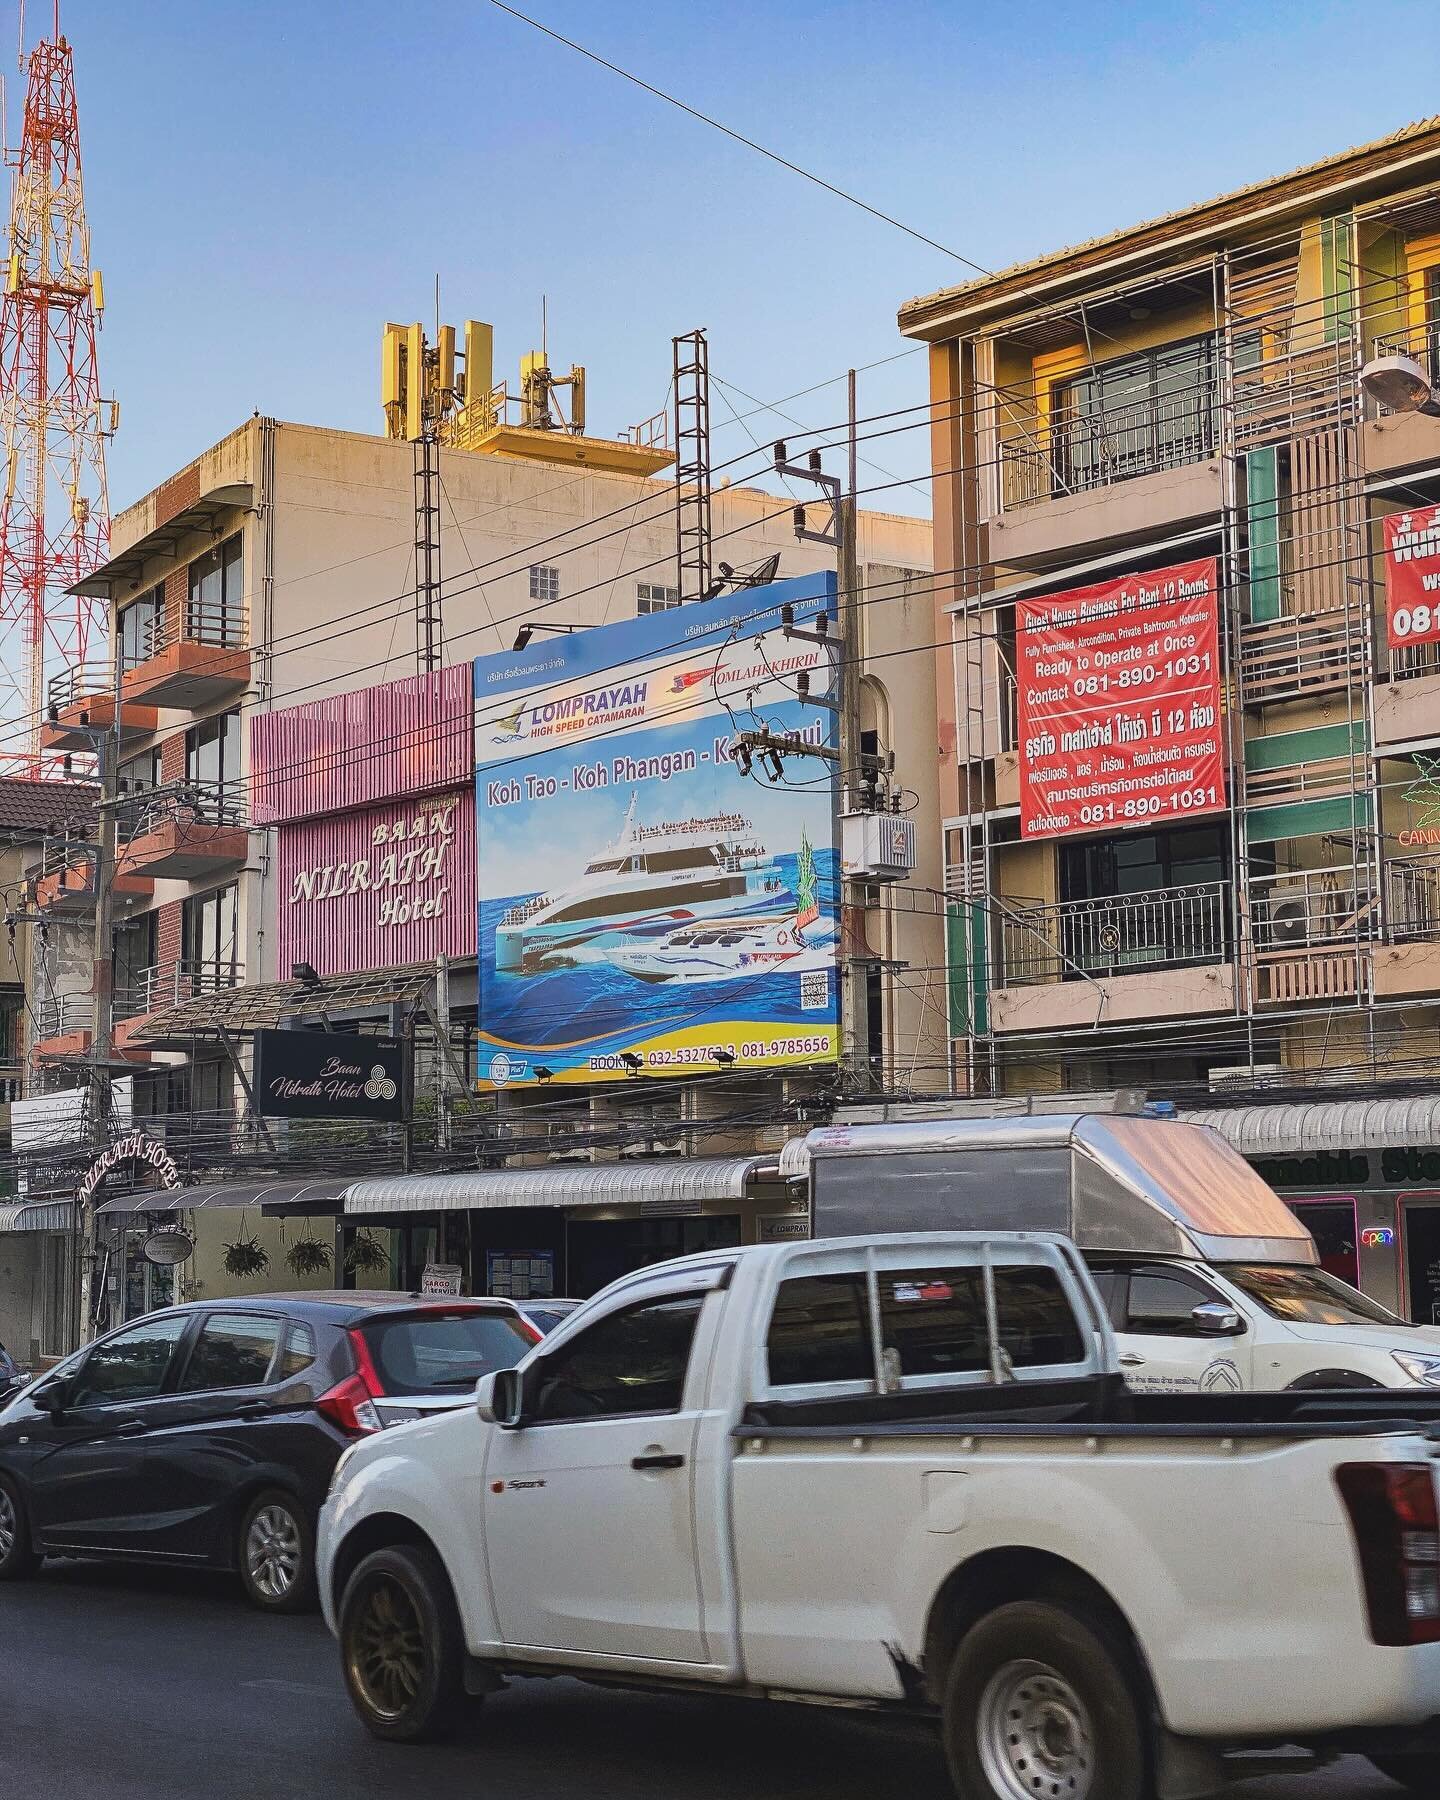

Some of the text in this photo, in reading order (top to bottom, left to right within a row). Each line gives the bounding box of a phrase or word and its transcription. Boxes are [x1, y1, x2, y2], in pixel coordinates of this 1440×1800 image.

[1026, 578, 1208, 634] Guest House Business For Rent 12 Rooms
[1026, 610, 1208, 658] Fully Furnished, Aircondition, Private Bahtroom, Hotwater
[1036, 633, 1195, 678] Ready to Operate at Once
[1027, 653, 1211, 706] Contact 081-890-1031
[530, 706, 645, 739] HIGH SPEED CATAMARAN
[531, 682, 648, 725] LOMPRAYAH
[1026, 730, 1056, 765] ธุรกิจ
[1115, 712, 1147, 743] ให้เช่า
[1152, 709, 1161, 737] มี
[1168, 709, 1185, 734] 12
[1190, 701, 1214, 729] ห้อง
[488, 779, 521, 807] Koh
[526, 775, 556, 800] Tao
[572, 764, 607, 791] Koh
[613, 750, 695, 783] Phangan
[1076, 760, 1091, 776] แอร์
[372, 806, 455, 847] BAAN
[1028, 812, 1070, 832] สนใจติดต่อ
[1080, 786, 1216, 825] 081-890-1031
[288, 838, 454, 904] NILRATH
[377, 887, 451, 927] Hotel
[320, 1056, 361, 1077] Baan
[742, 1037, 829, 1057] 081-9785656
[270, 1076, 364, 1101] Nilrath Hotel
[1361, 1232, 1393, 1248] open
[425, 1280, 450, 1288] CARGO
